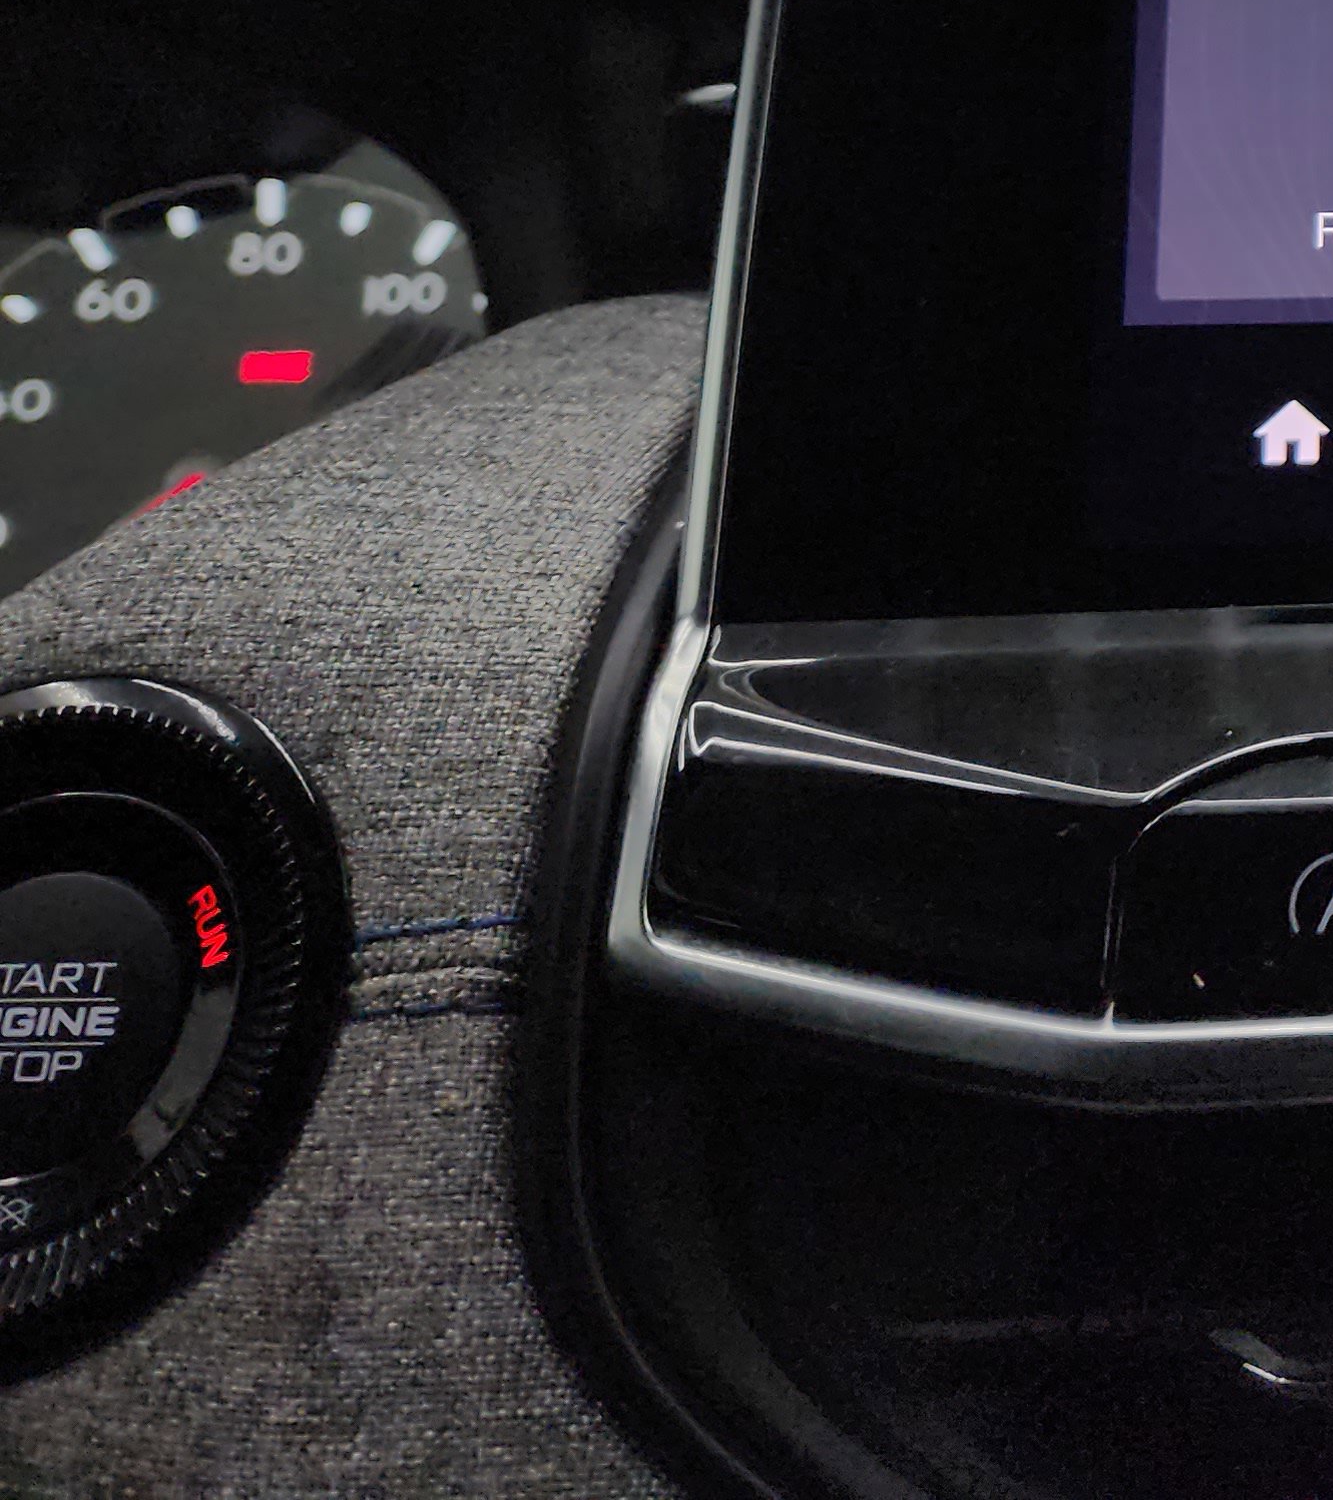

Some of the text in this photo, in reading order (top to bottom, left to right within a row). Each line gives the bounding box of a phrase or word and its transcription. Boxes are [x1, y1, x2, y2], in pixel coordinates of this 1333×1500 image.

[228, 231, 302, 276] 80
[74, 277, 153, 322] 60
[362, 271, 447, 316] 100
[187, 885, 229, 968] RUN
[0, 962, 118, 993] TART
